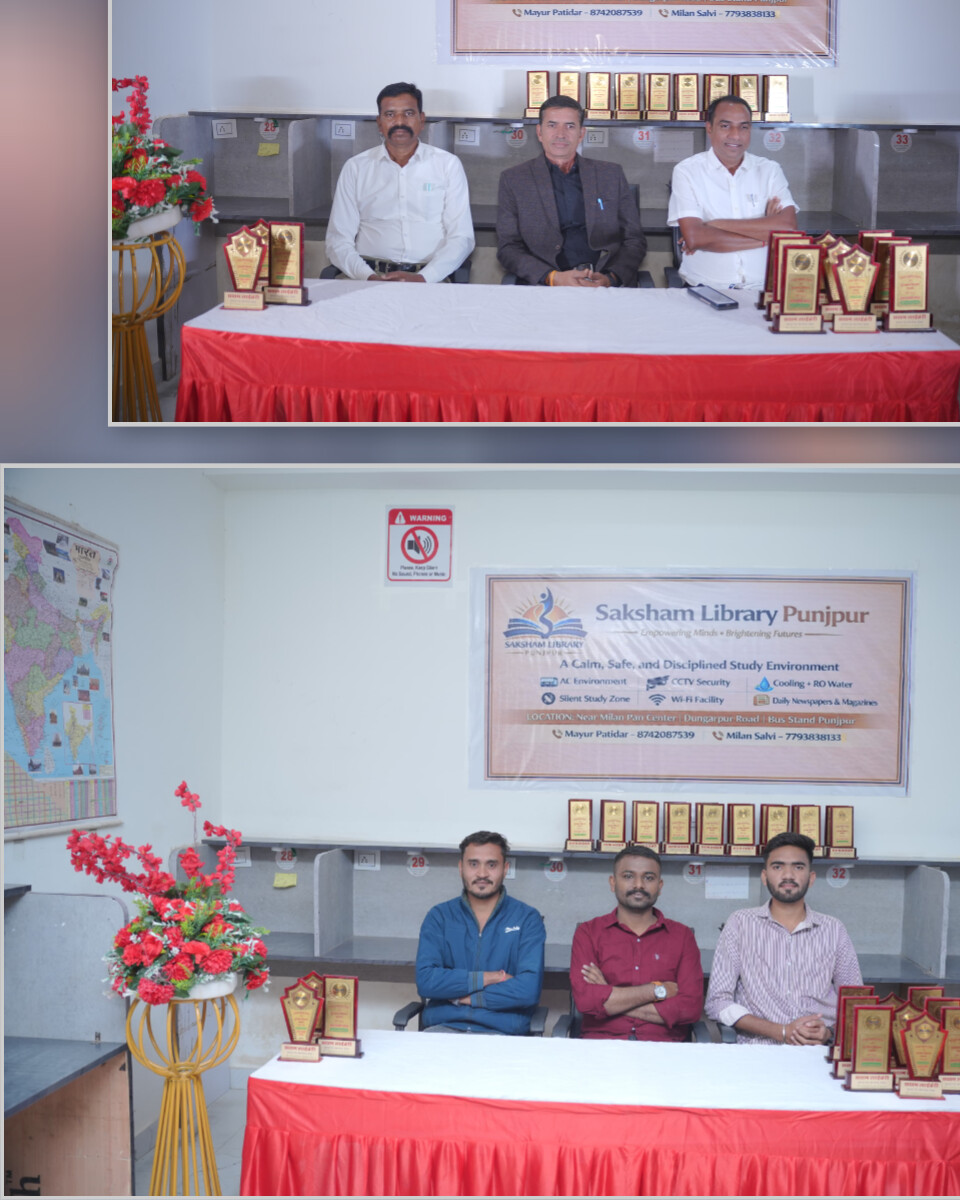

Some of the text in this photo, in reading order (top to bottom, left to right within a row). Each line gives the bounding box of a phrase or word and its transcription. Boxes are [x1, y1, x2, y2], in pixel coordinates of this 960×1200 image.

[524, 9, 551, 17] Mayur
[511, 129, 523, 140] 30
[638, 130, 650, 140] 31
[768, 132, 781, 143] 32
[896, 134, 908, 145] 33
[595, 604, 870, 627] Saksham Library Punjpur
[559, 659, 840, 672] A Calm, Safe, and Disciplined Study Environment
[565, 730, 695, 739] Mayur Patidar 8742087539
[726, 732, 841, 741] Milan Salvi 7793838133
[412, 857, 425, 868] 29
[550, 862, 563, 873] 30
[831, 867, 846, 879] 32
